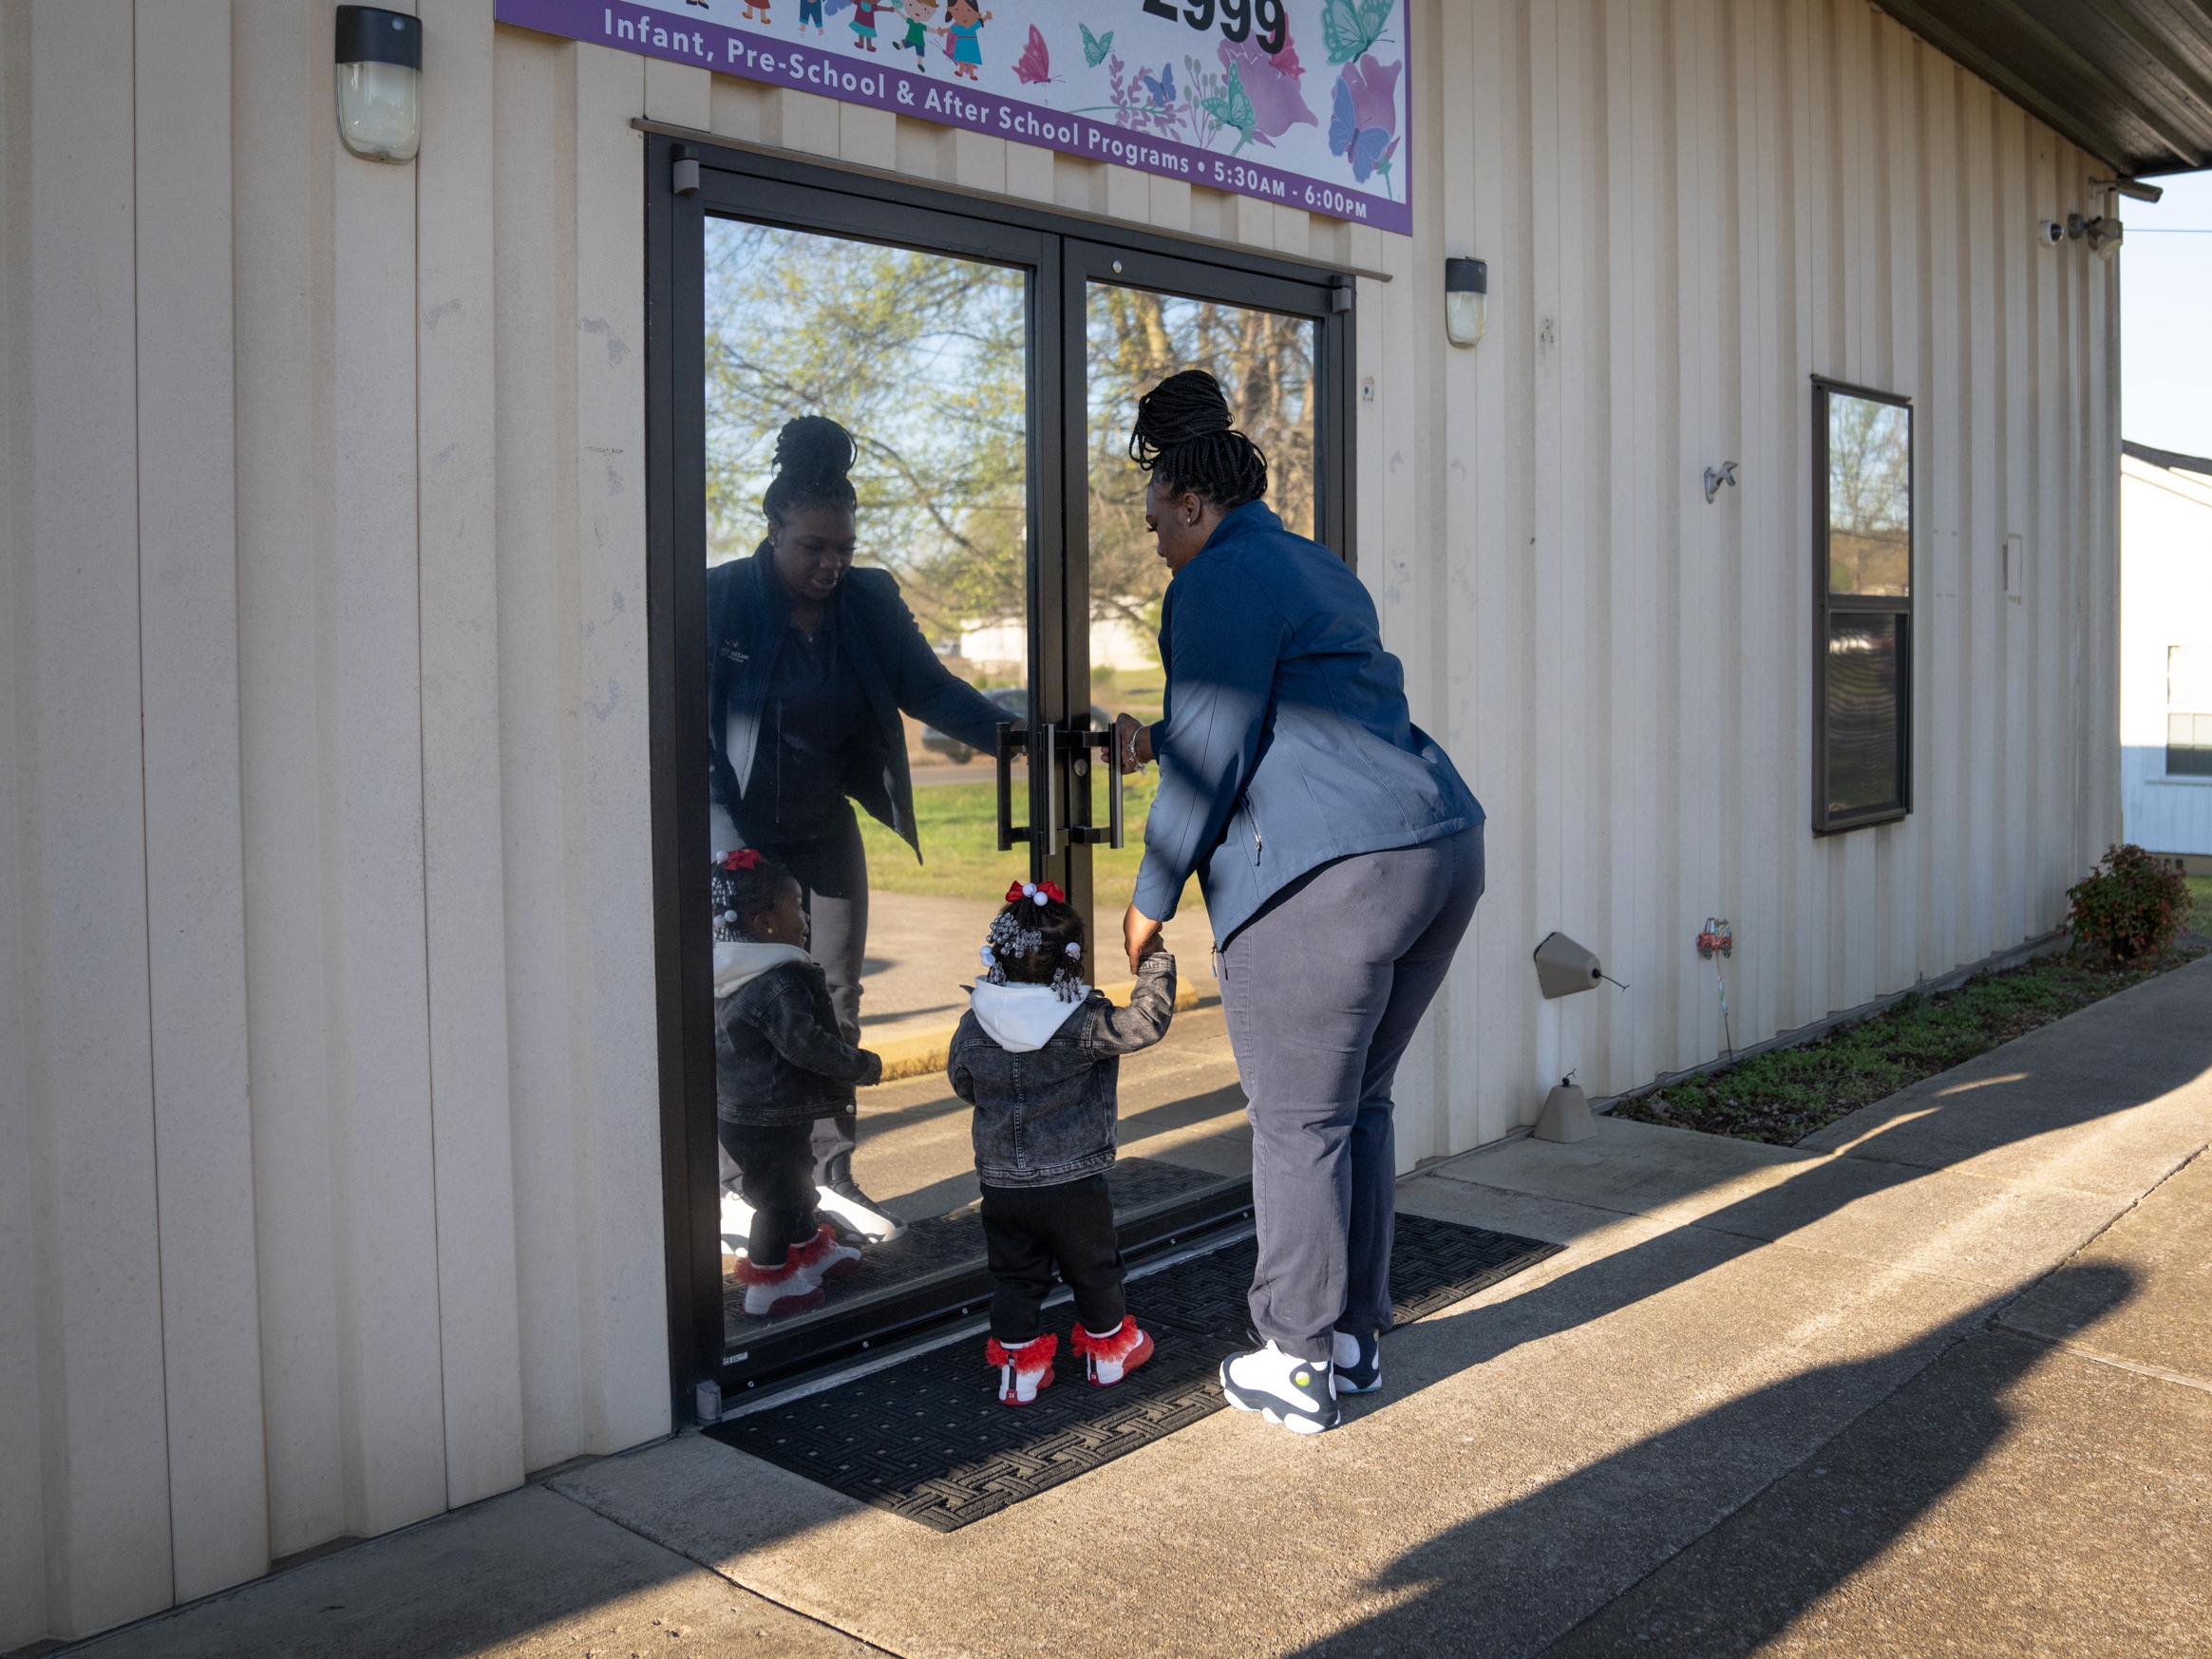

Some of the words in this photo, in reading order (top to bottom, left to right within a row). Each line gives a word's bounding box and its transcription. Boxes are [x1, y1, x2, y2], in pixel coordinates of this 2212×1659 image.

[1143, 0, 1286, 55] 999
[604, 8, 714, 63] Infant,
[728, 37, 885, 99] Pre-School
[896, 80, 916, 106] &
[923, 87, 990, 123] After
[998, 105, 1079, 146] School
[1087, 127, 1190, 174] Programs
[1213, 160, 1286, 198] 5:30AM
[1304, 184, 1368, 219] 6:00PM
